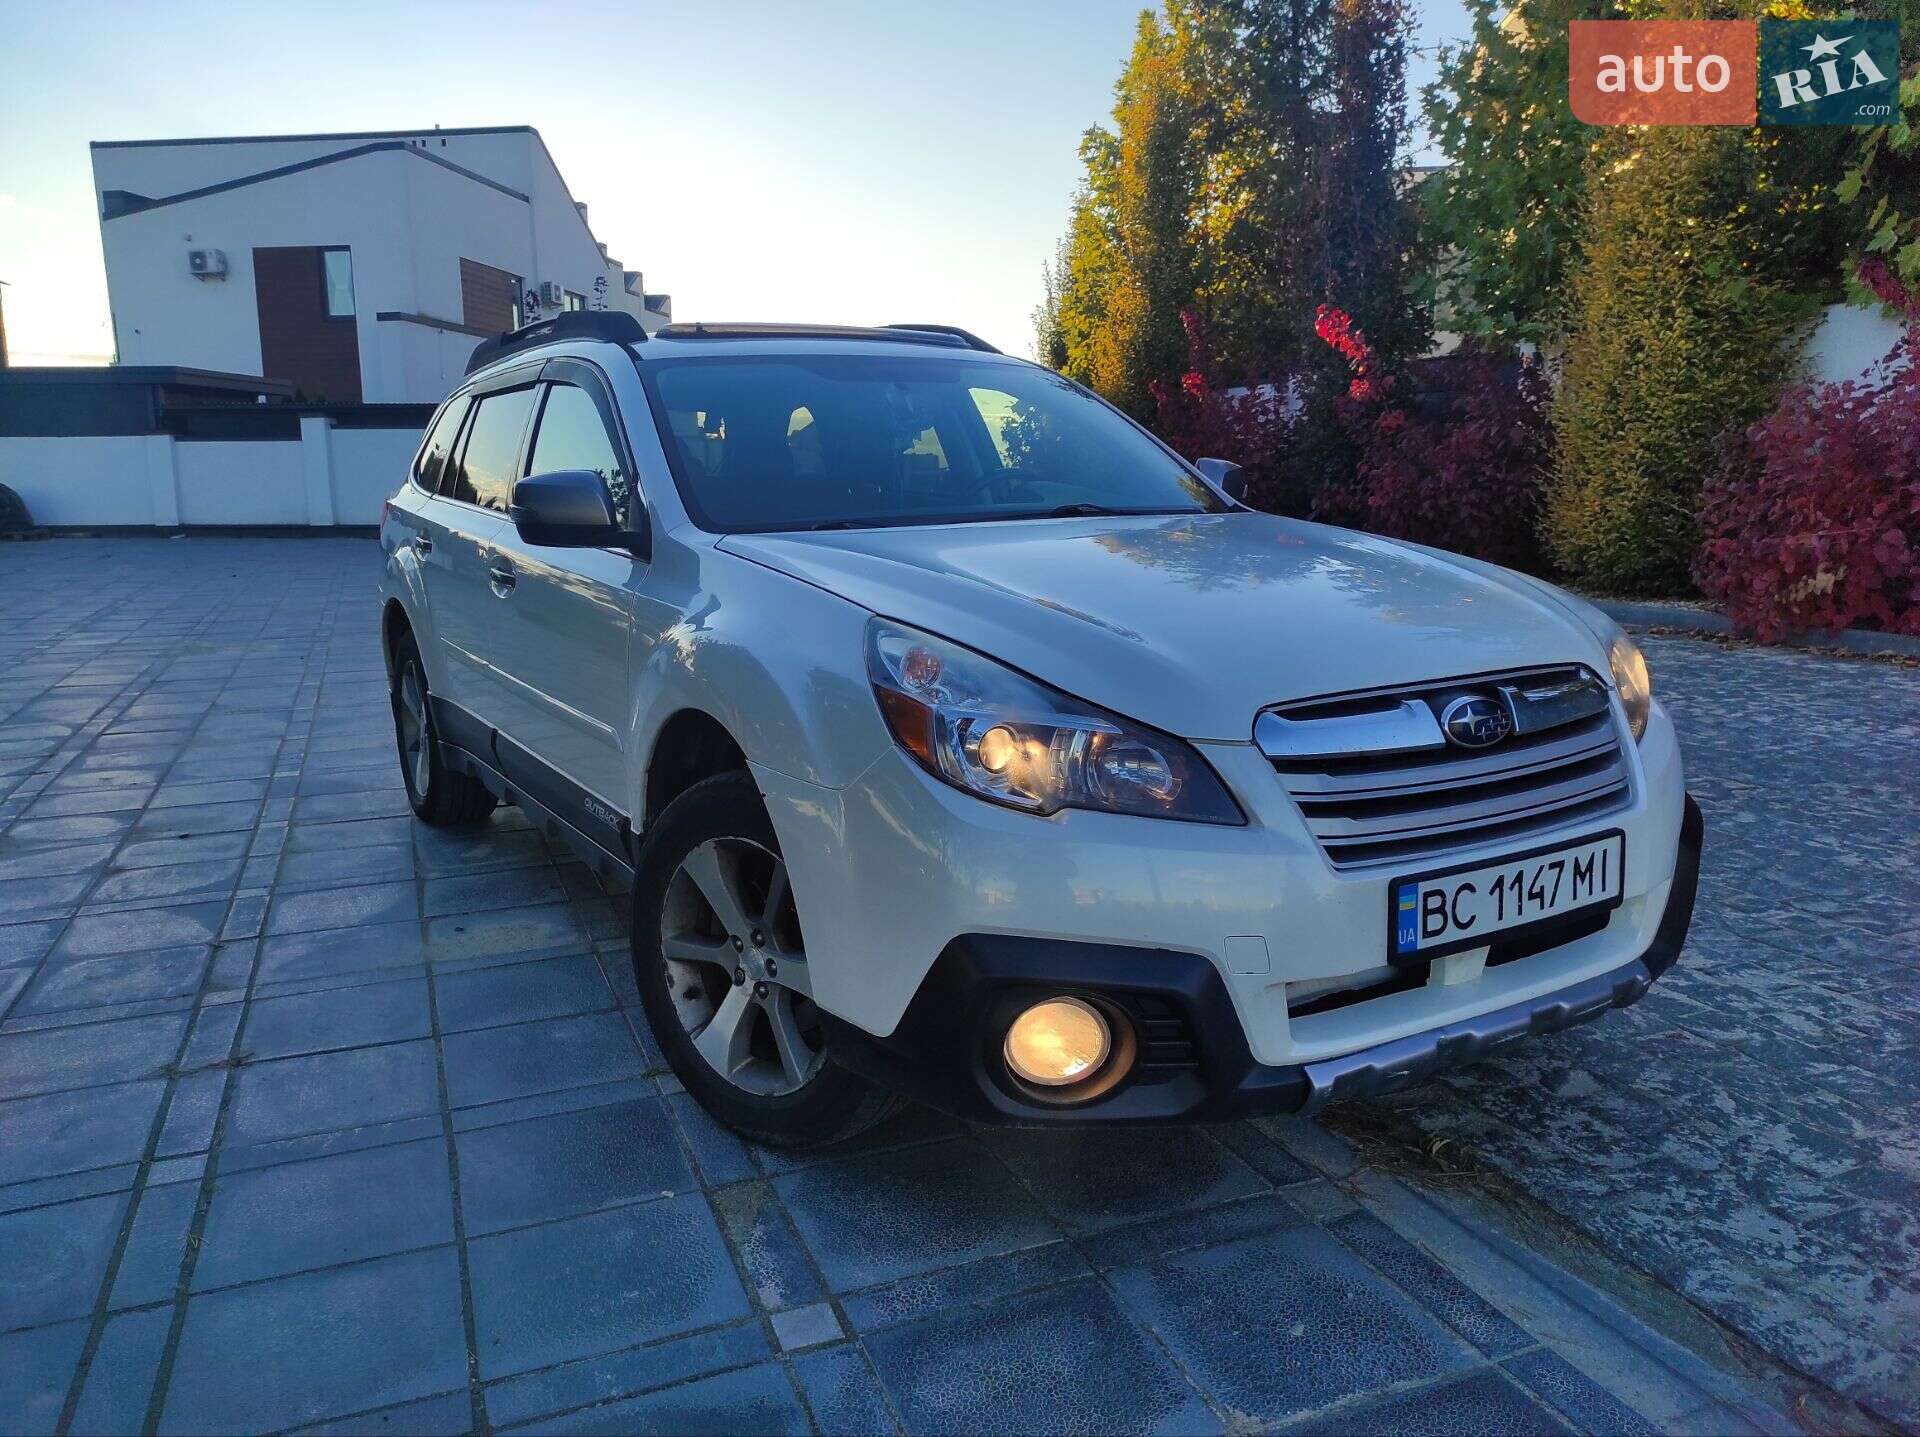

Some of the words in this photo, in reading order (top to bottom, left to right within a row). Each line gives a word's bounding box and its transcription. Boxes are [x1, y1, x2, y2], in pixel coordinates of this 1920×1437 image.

[584, 797, 621, 829] OUTBACK
[1422, 882, 1477, 939] BC
[1488, 859, 1566, 922] 1147
[1399, 927, 1416, 944] UA
